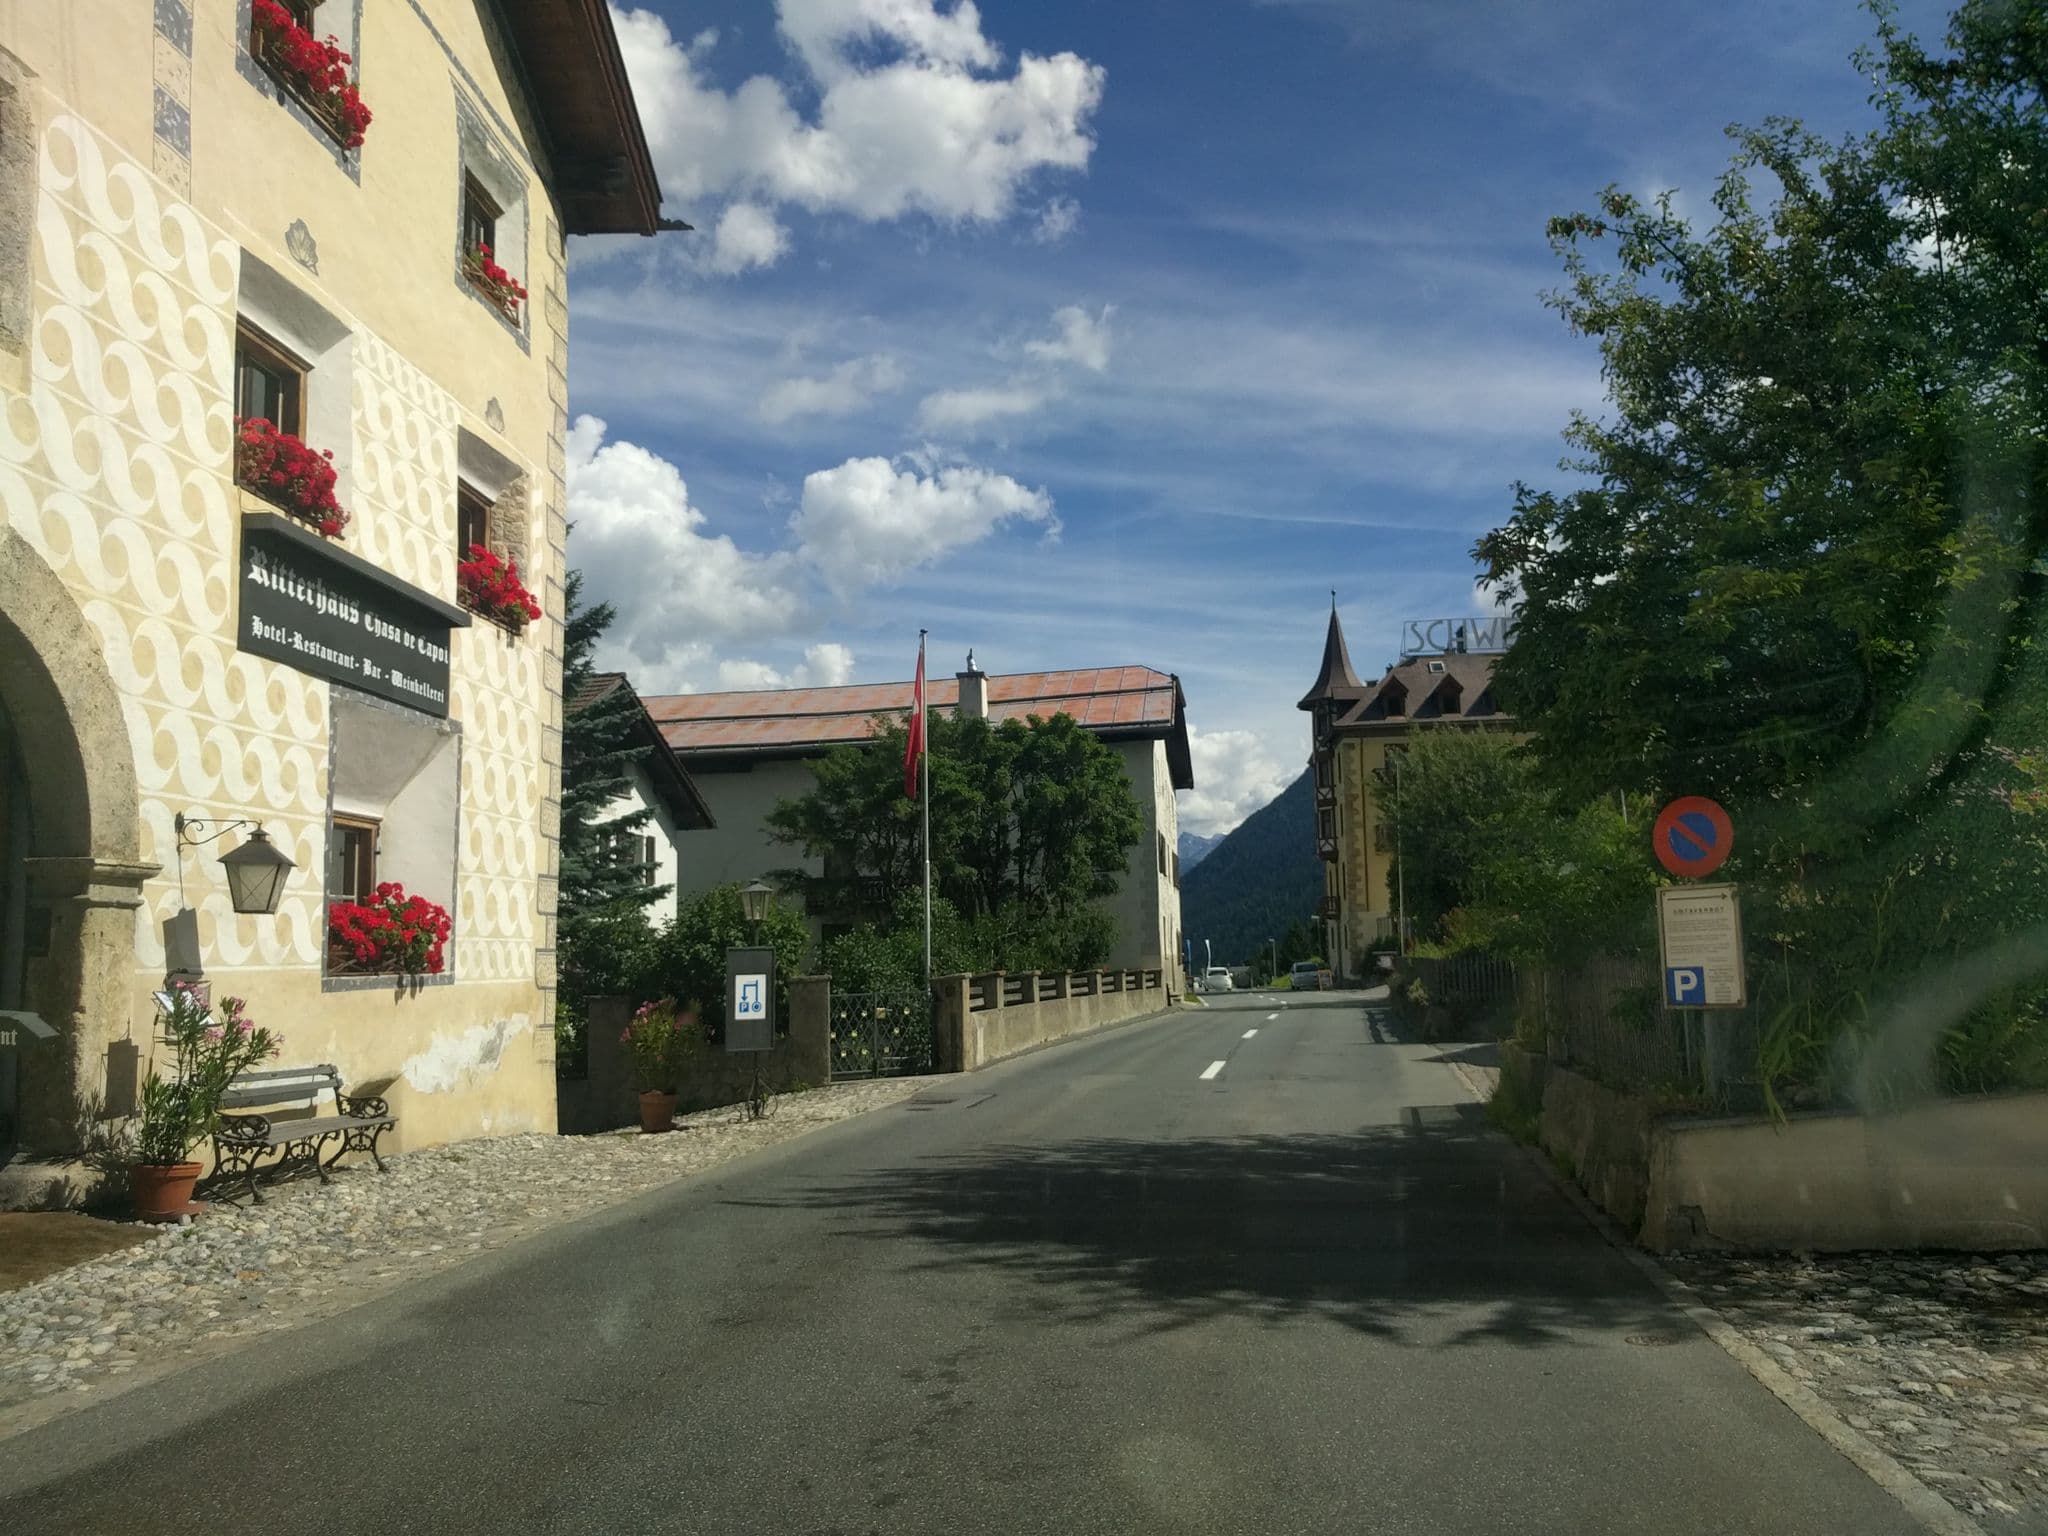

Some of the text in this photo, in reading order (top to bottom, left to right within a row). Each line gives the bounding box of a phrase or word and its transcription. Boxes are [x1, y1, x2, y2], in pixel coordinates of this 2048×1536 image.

[247, 546, 360, 625] Ritterhaus
[364, 611, 401, 644] Chasa
[403, 627, 416, 650] de
[362, 657, 382, 680] Bar
[391, 668, 445, 703] Weinkellerei
[1674, 970, 1698, 1001] P
